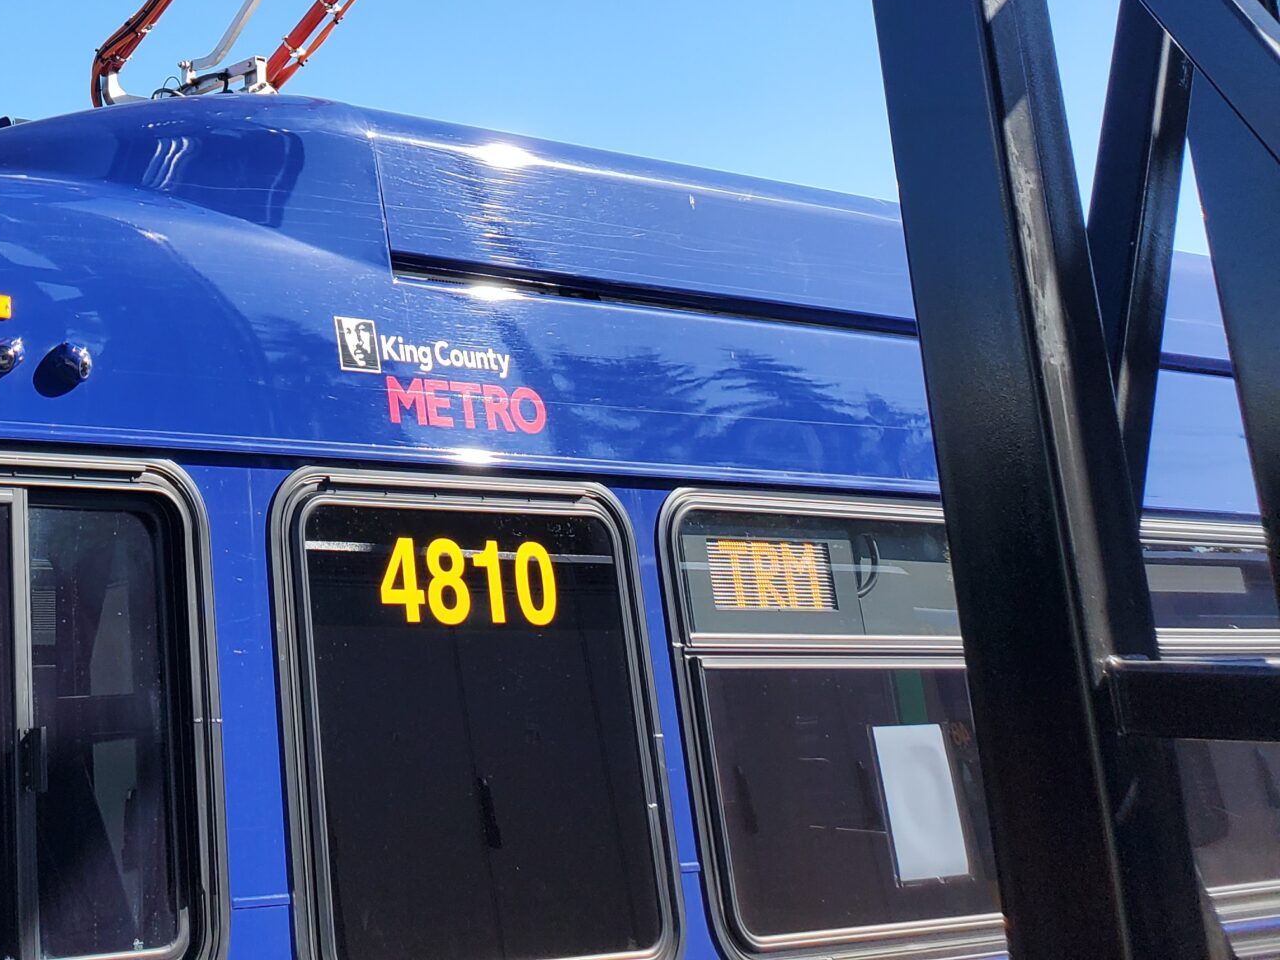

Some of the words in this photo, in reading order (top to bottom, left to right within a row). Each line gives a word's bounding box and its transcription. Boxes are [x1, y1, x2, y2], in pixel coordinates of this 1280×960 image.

[380, 334, 433, 372] King
[434, 341, 510, 379] County
[386, 375, 547, 434] METRO
[381, 537, 557, 626] 4810
[718, 540, 822, 608] TRM
